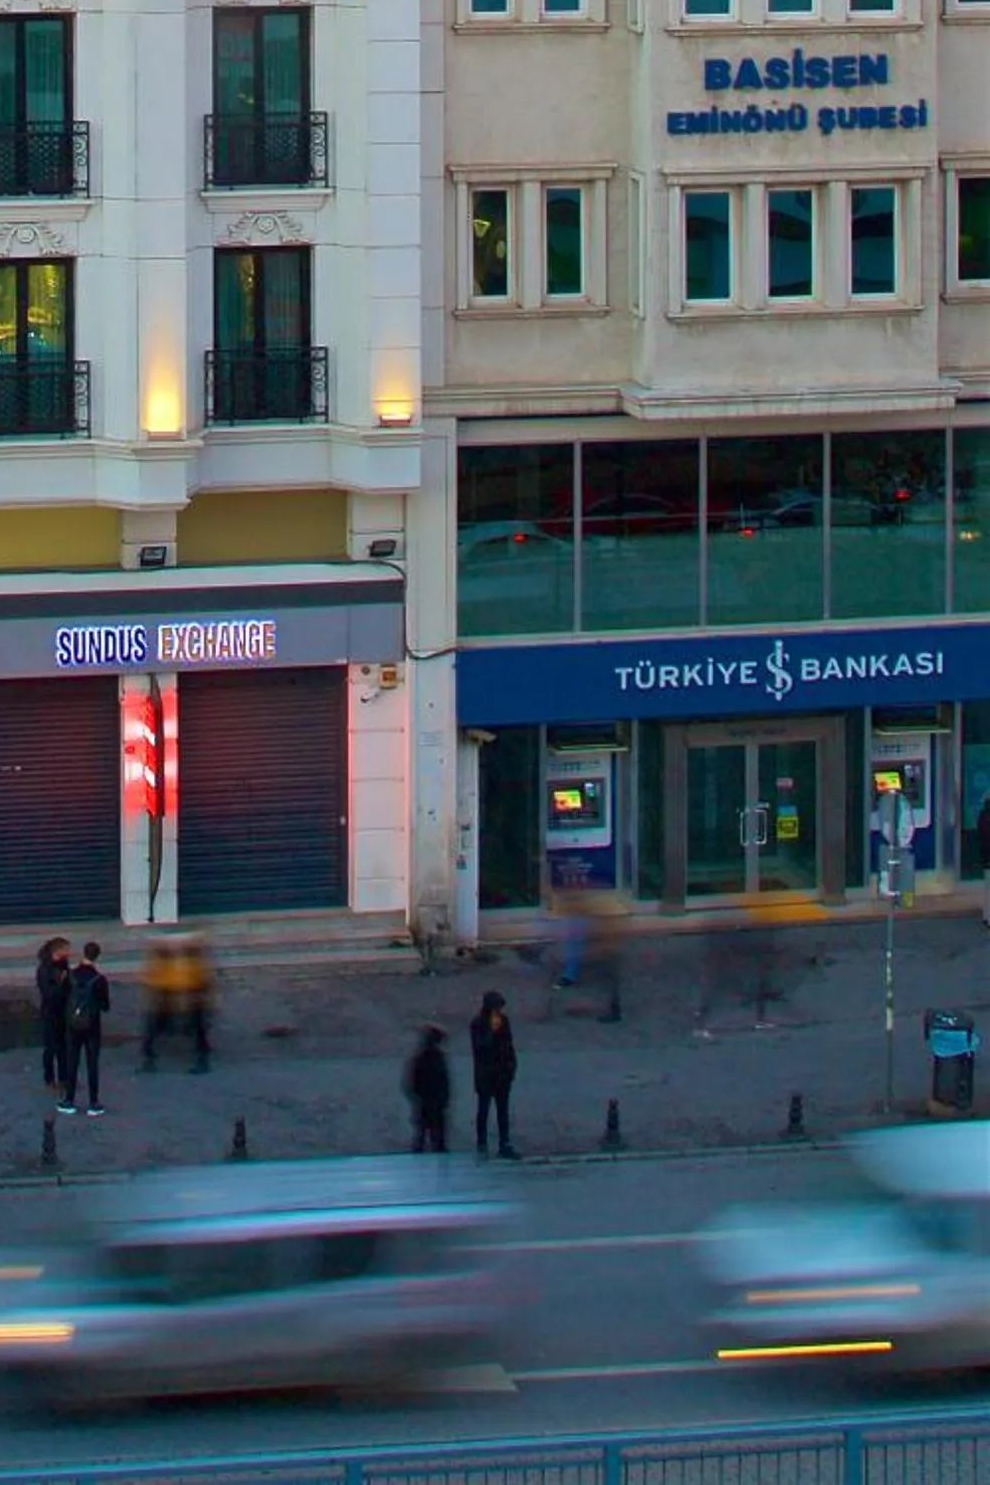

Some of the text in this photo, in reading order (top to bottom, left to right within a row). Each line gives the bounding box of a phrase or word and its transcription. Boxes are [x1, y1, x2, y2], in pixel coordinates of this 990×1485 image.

[704, 48, 888, 90] BASİSEN
[666, 99, 928, 135] EMİNÖNÜ ŞUBESİ
[57, 619, 276, 666] SUNDUS EXCHANGE
[615, 657, 758, 690] TÜRKİYE
[800, 652, 944, 681] BANKASI
